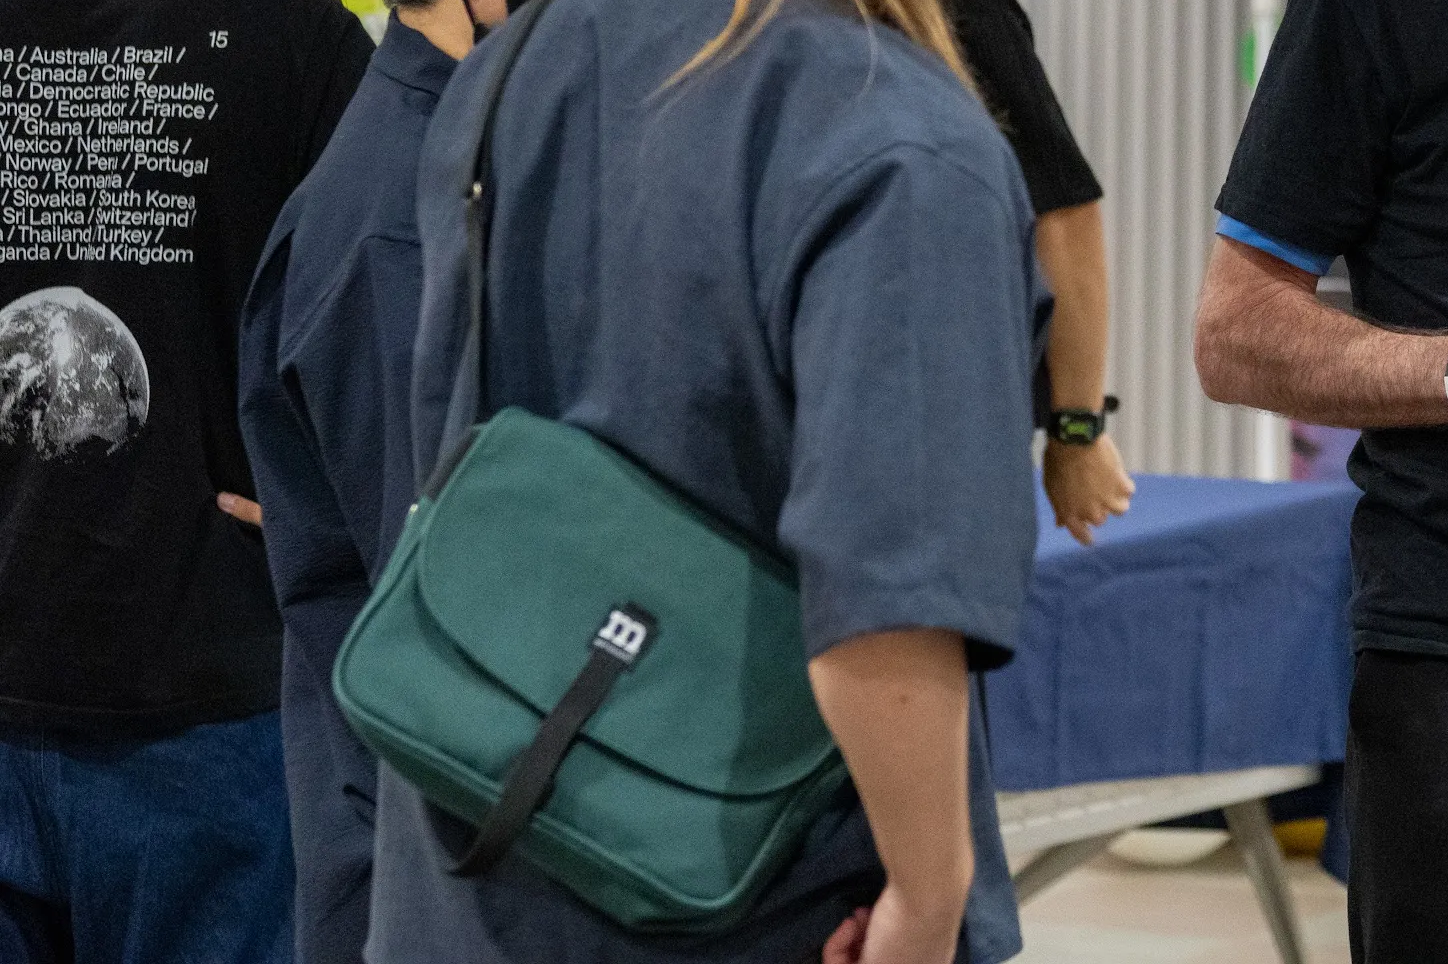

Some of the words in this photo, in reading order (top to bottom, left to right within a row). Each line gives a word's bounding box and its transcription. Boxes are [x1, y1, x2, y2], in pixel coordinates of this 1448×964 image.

[210, 31, 228, 48] 15
[30, 46, 107, 65] Australia
[124, 46, 172, 63] Brazil
[16, 63, 87, 82] Canada
[102, 64, 145, 81] Chile
[30, 82, 129, 100] Democratic
[134, 82, 214, 103] Republic
[58, 100, 127, 118] Ecuador
[142, 99, 205, 119] France
[23, 116, 82, 135] Ghana
[98, 117, 153, 134] Ireland
[78, 135, 179, 154] Netherlands
[6, 153, 72, 174] Norway
[134, 153, 208, 177] Portugal
[1, 170, 38, 189] Rico
[13, 189, 85, 207] Slovakia
[99, 189, 141, 206] South
[146, 190, 195, 209] Korea
[3, 207, 25, 224] Sri
[30, 208, 84, 225] Lanka
[96, 207, 189, 228] Switzerland
[18, 225, 92, 243] Thailand
[97, 224, 152, 247] Turkey
[110, 243, 193, 265] Kingdom
